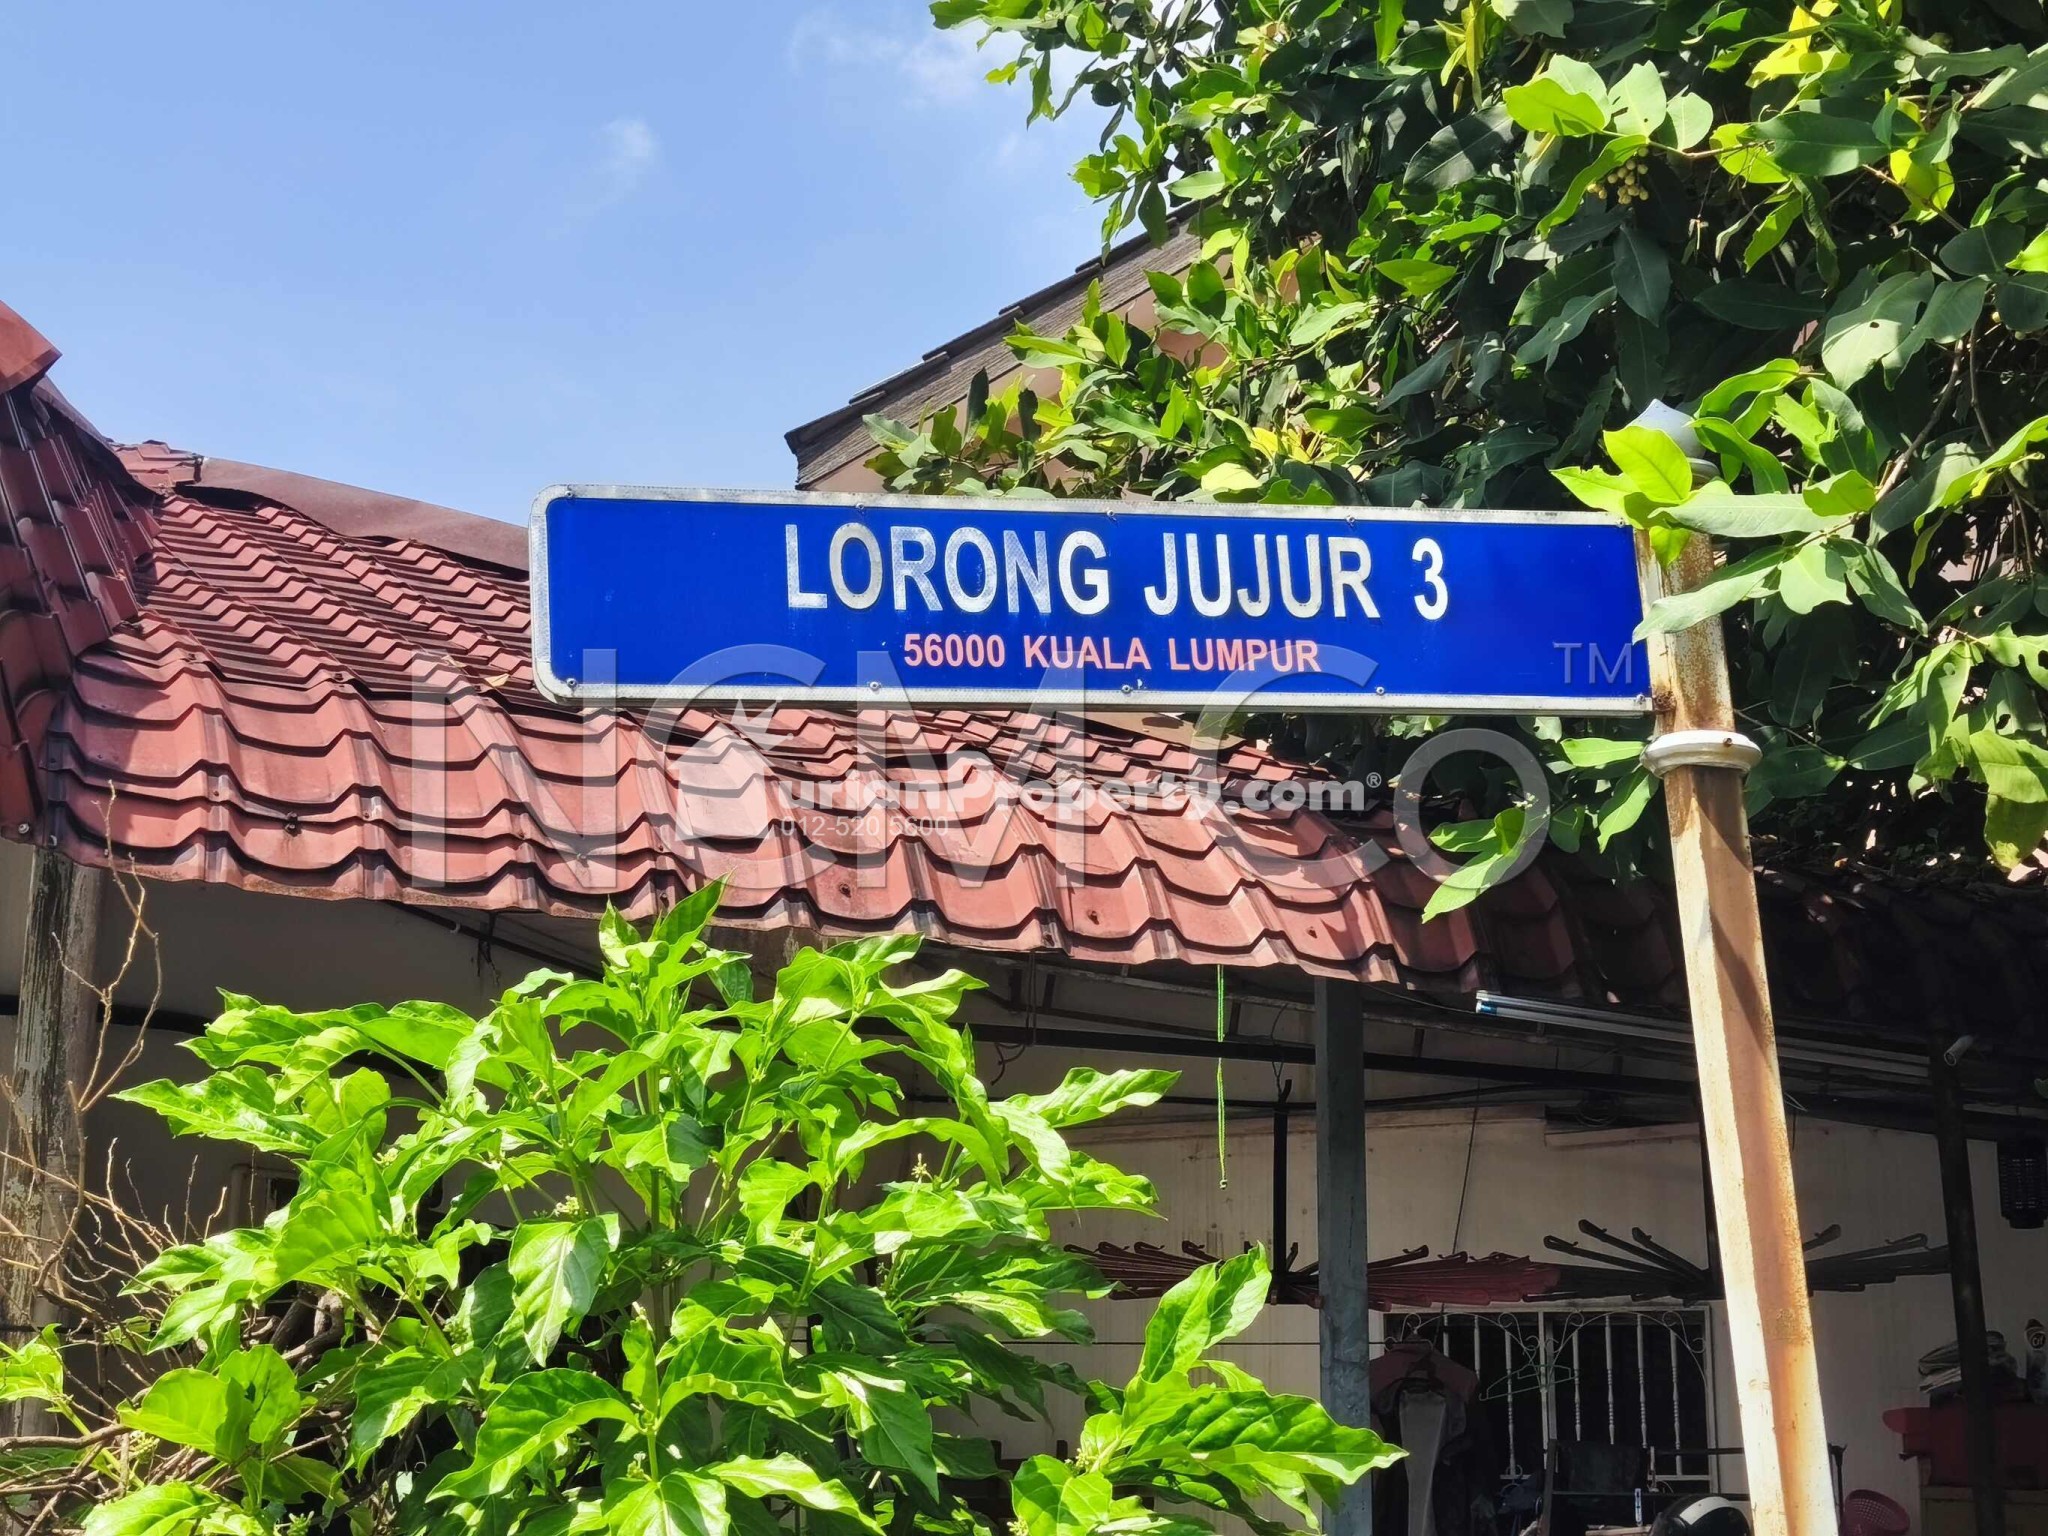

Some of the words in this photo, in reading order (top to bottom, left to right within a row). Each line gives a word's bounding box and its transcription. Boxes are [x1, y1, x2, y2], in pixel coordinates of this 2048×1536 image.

[785, 522, 1110, 616] LORONG
[1144, 532, 1381, 619] JUJUR
[1411, 537, 1449, 621] 3
[904, 633, 1006, 668] 56000
[1023, 634, 1151, 670] KUALA
[1168, 637, 1322, 673] LUMPUR
